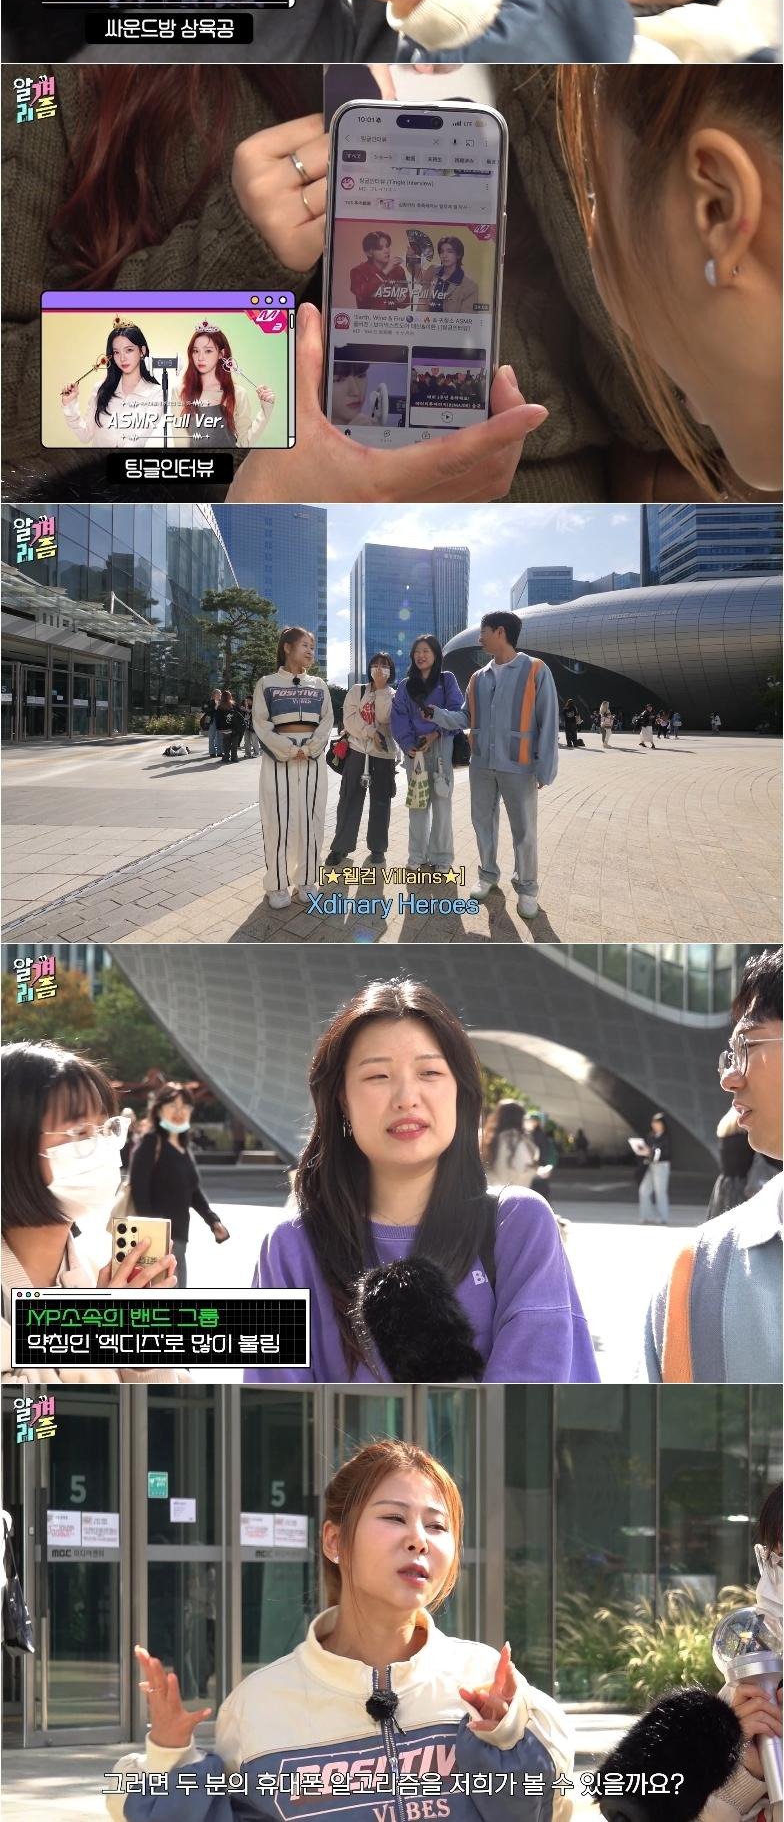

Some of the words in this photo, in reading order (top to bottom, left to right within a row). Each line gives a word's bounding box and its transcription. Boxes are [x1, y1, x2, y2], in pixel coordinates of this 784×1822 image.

[375, 286, 408, 299] ASMR
[410, 287, 428, 299] Full
[272, 688, 321, 698] POSITIVE
[69, 1475, 87, 1503] 5
[271, 1481, 286, 1507] 5
